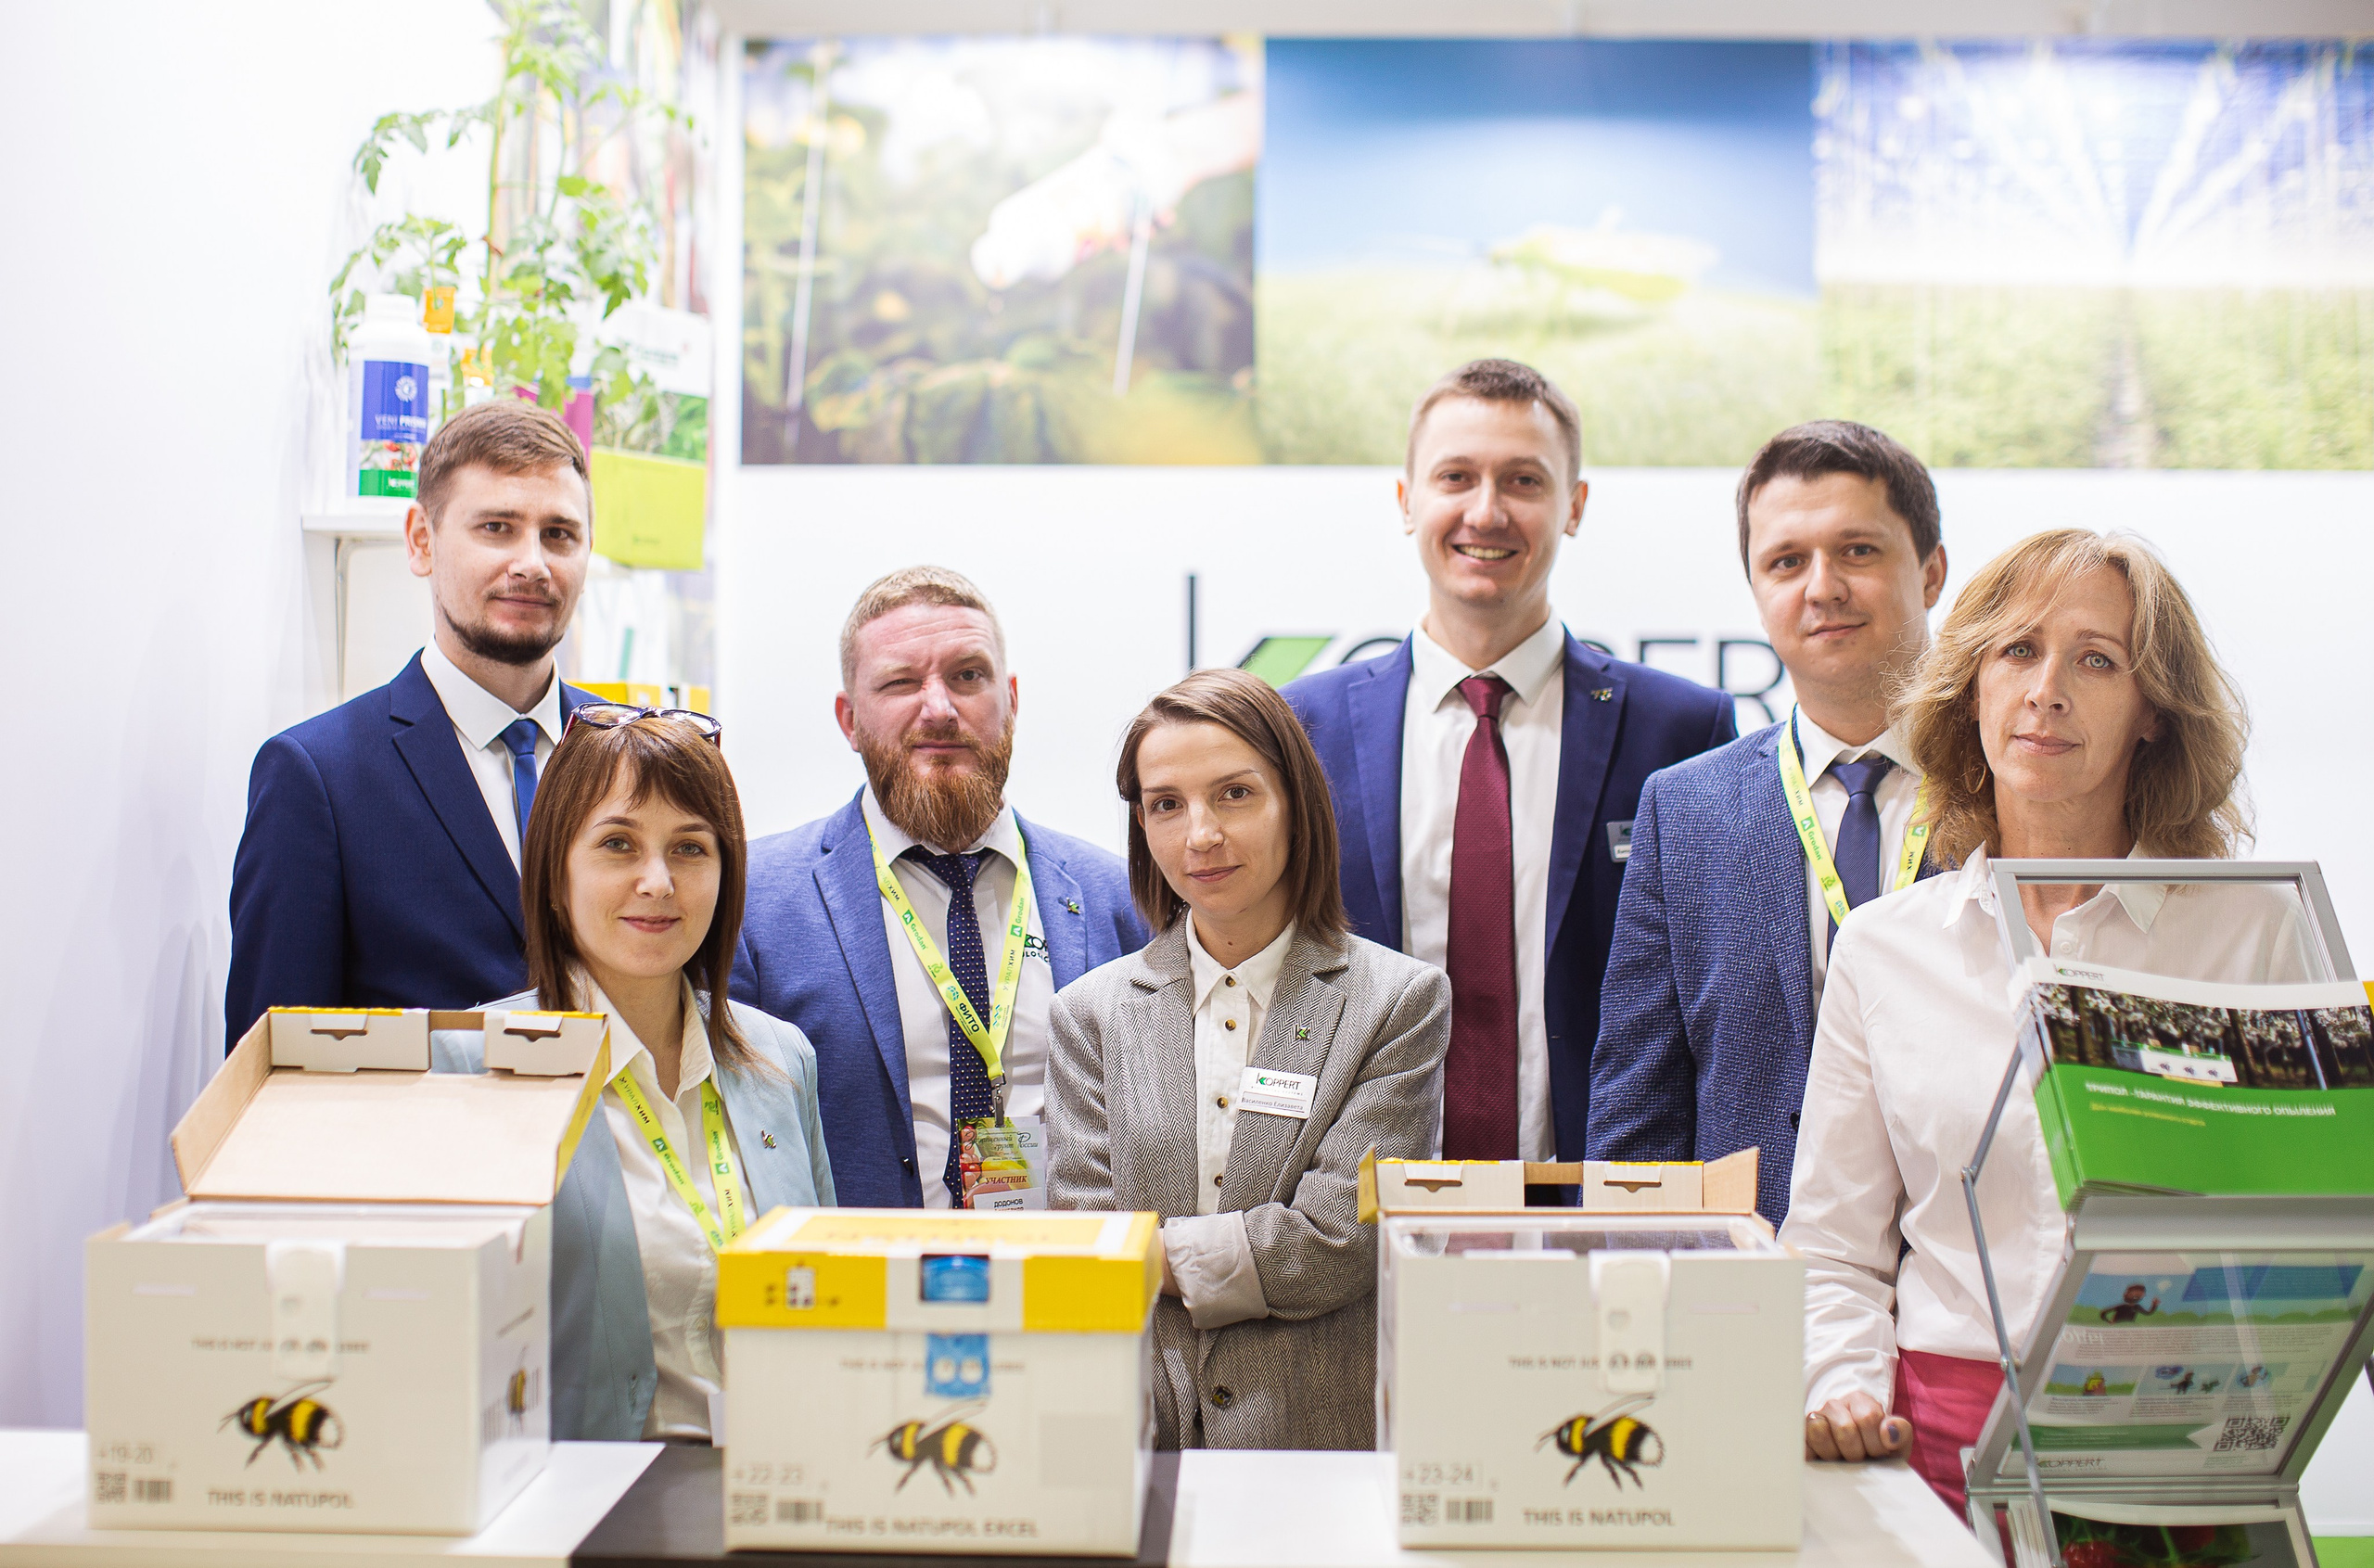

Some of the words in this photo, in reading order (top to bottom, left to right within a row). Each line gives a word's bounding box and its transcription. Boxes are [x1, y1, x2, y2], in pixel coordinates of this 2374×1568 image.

[1808, 831, 1822, 860] Grodan
[1015, 897, 1025, 924] Grodan
[910, 924, 926, 950] Grodan
[2052, 963, 2105, 982] KOPPERT
[959, 1002, 979, 1033] ФИТО
[1256, 1072, 1301, 1090] KOPPERT
[2187, 1099, 2272, 1115] ЭФФЕКТИВНОГО
[2273, 1103, 2336, 1116] ОПЫЛЕНИЯ
[986, 1175, 1027, 1185] УЧАСТНИК
[994, 1198, 1024, 1208] ДОДОНОВ
[208, 1488, 245, 1507] THIS
[249, 1489, 266, 1508] IS
[270, 1490, 355, 1510] NATUPOL
[1523, 1509, 1564, 1527] THIS
[1567, 1509, 1585, 1527] IS
[1589, 1509, 1677, 1527] NATUPOL
